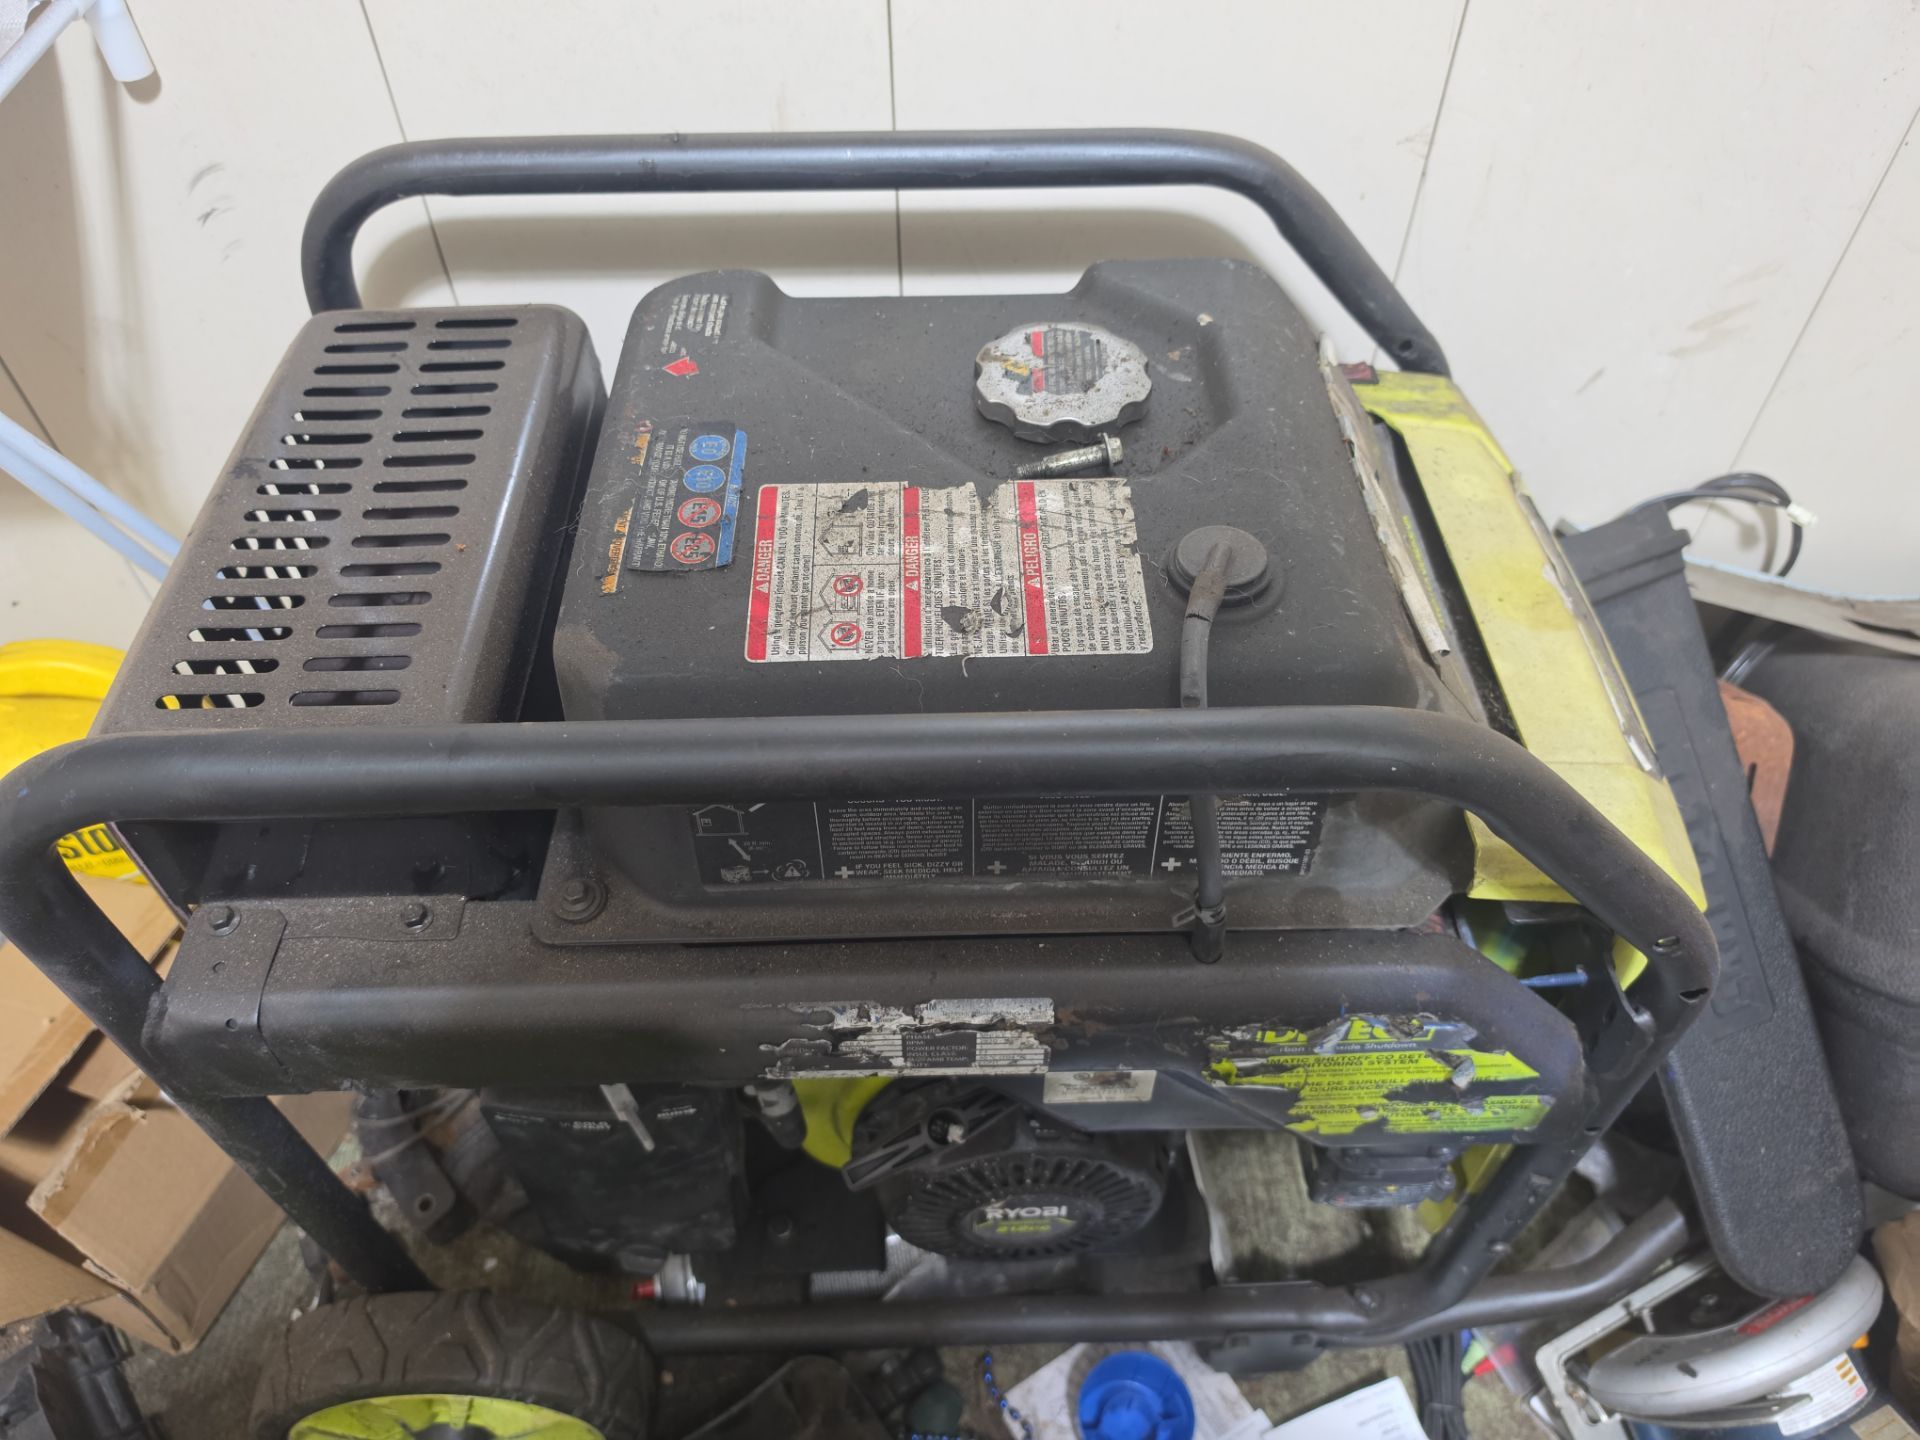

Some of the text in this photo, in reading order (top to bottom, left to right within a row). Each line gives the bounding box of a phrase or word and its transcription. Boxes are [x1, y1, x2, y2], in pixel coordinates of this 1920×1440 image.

[689, 502, 708, 522] E15
[778, 526, 787, 540] YOU
[777, 542, 786, 554] KILL
[904, 535, 918, 576] DANGER
[1022, 532, 1039, 575] PELIGRO
[755, 539, 772, 580] DANGER
[776, 556, 786, 568] CAN
[1114, 559, 1126, 578] LIBRE
[772, 595, 784, 627] generator
[876, 599, 885, 616] EVEN
[770, 635, 781, 655] Using
[785, 621, 796, 654] Generator
[797, 631, 808, 654] poison
[864, 631, 873, 653] NEVER
[934, 635, 944, 652] TUER
[1060, 628, 1071, 651] POCOS
[1077, 640, 1087, 651] Los
[1099, 626, 1111, 650] NUNCA
[1113, 638, 1123, 650] con
[875, 645, 885, 653] or
[1314, 1055, 1373, 1063] SHUTOFF
[984, 1205, 1068, 1220] RYOBI
